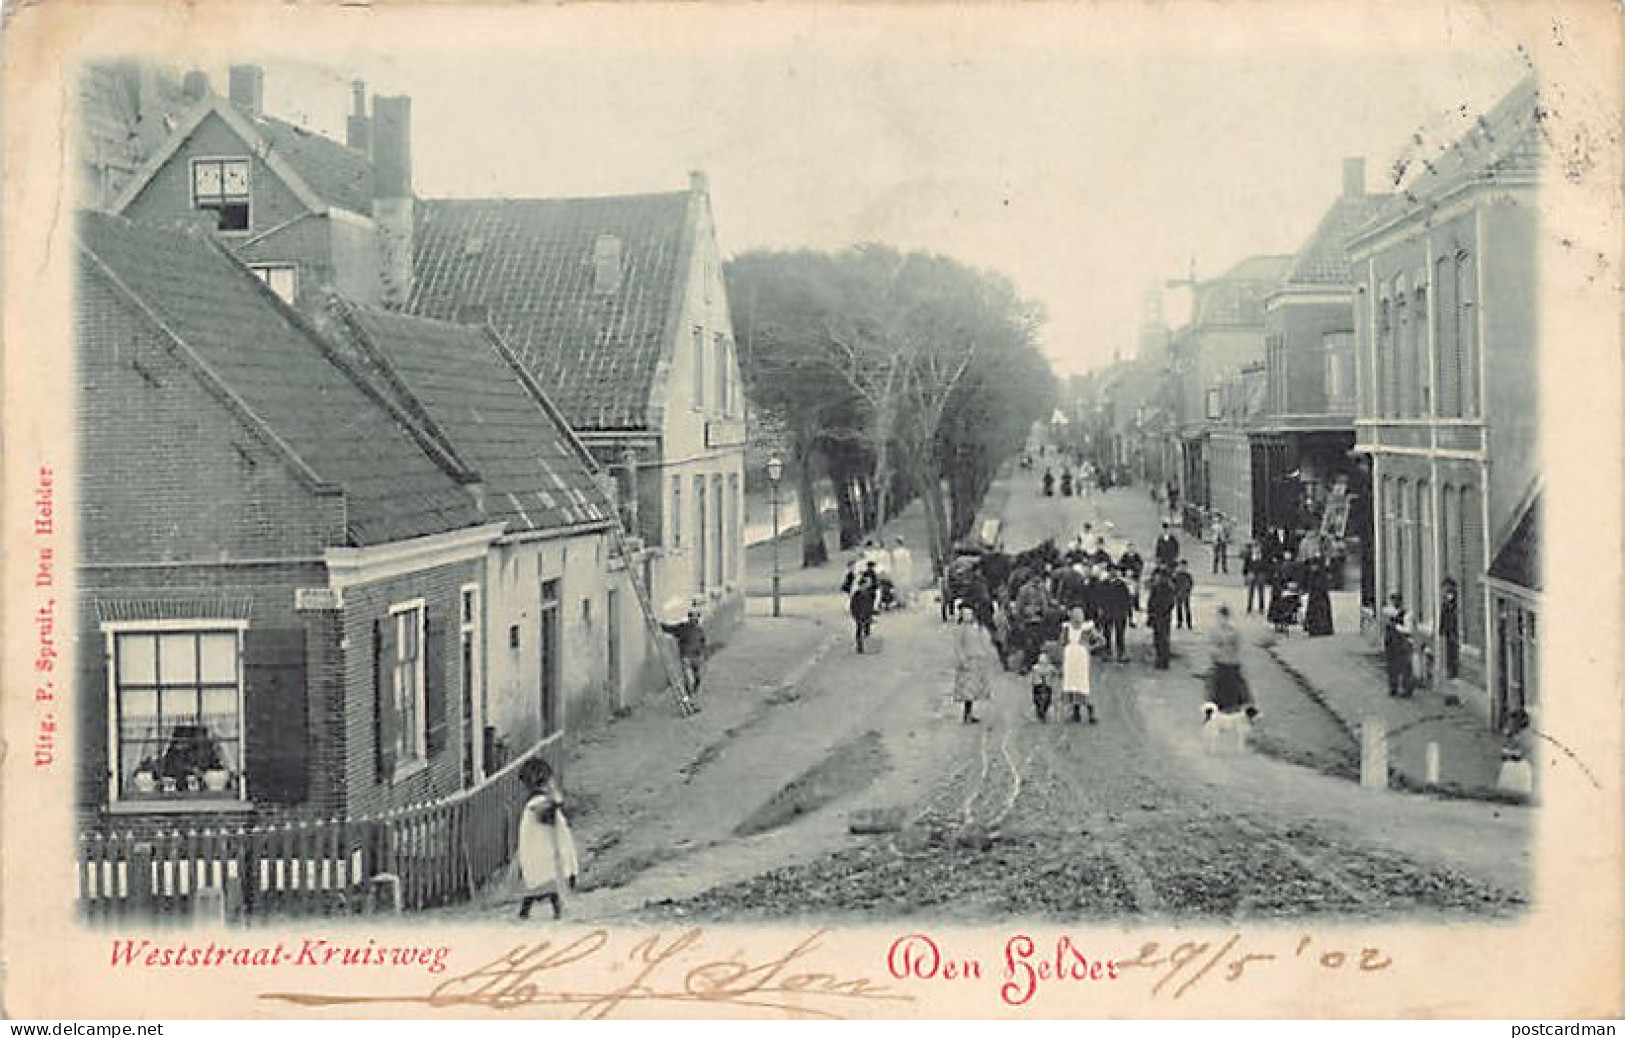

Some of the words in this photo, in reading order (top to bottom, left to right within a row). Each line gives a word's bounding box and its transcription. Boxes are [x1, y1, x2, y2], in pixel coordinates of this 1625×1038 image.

[35, 466, 53, 535] Helder
[35, 548, 53, 587] Den
[35, 599, 57, 672] Spruit,
[35, 682, 53, 701] P.
[35, 714, 56, 766] Uitg.
[109, 938, 452, 973] Weststraat-Kruisweg
[888, 935, 981, 980] Den
[1001, 935, 1120, 1006] Helder
